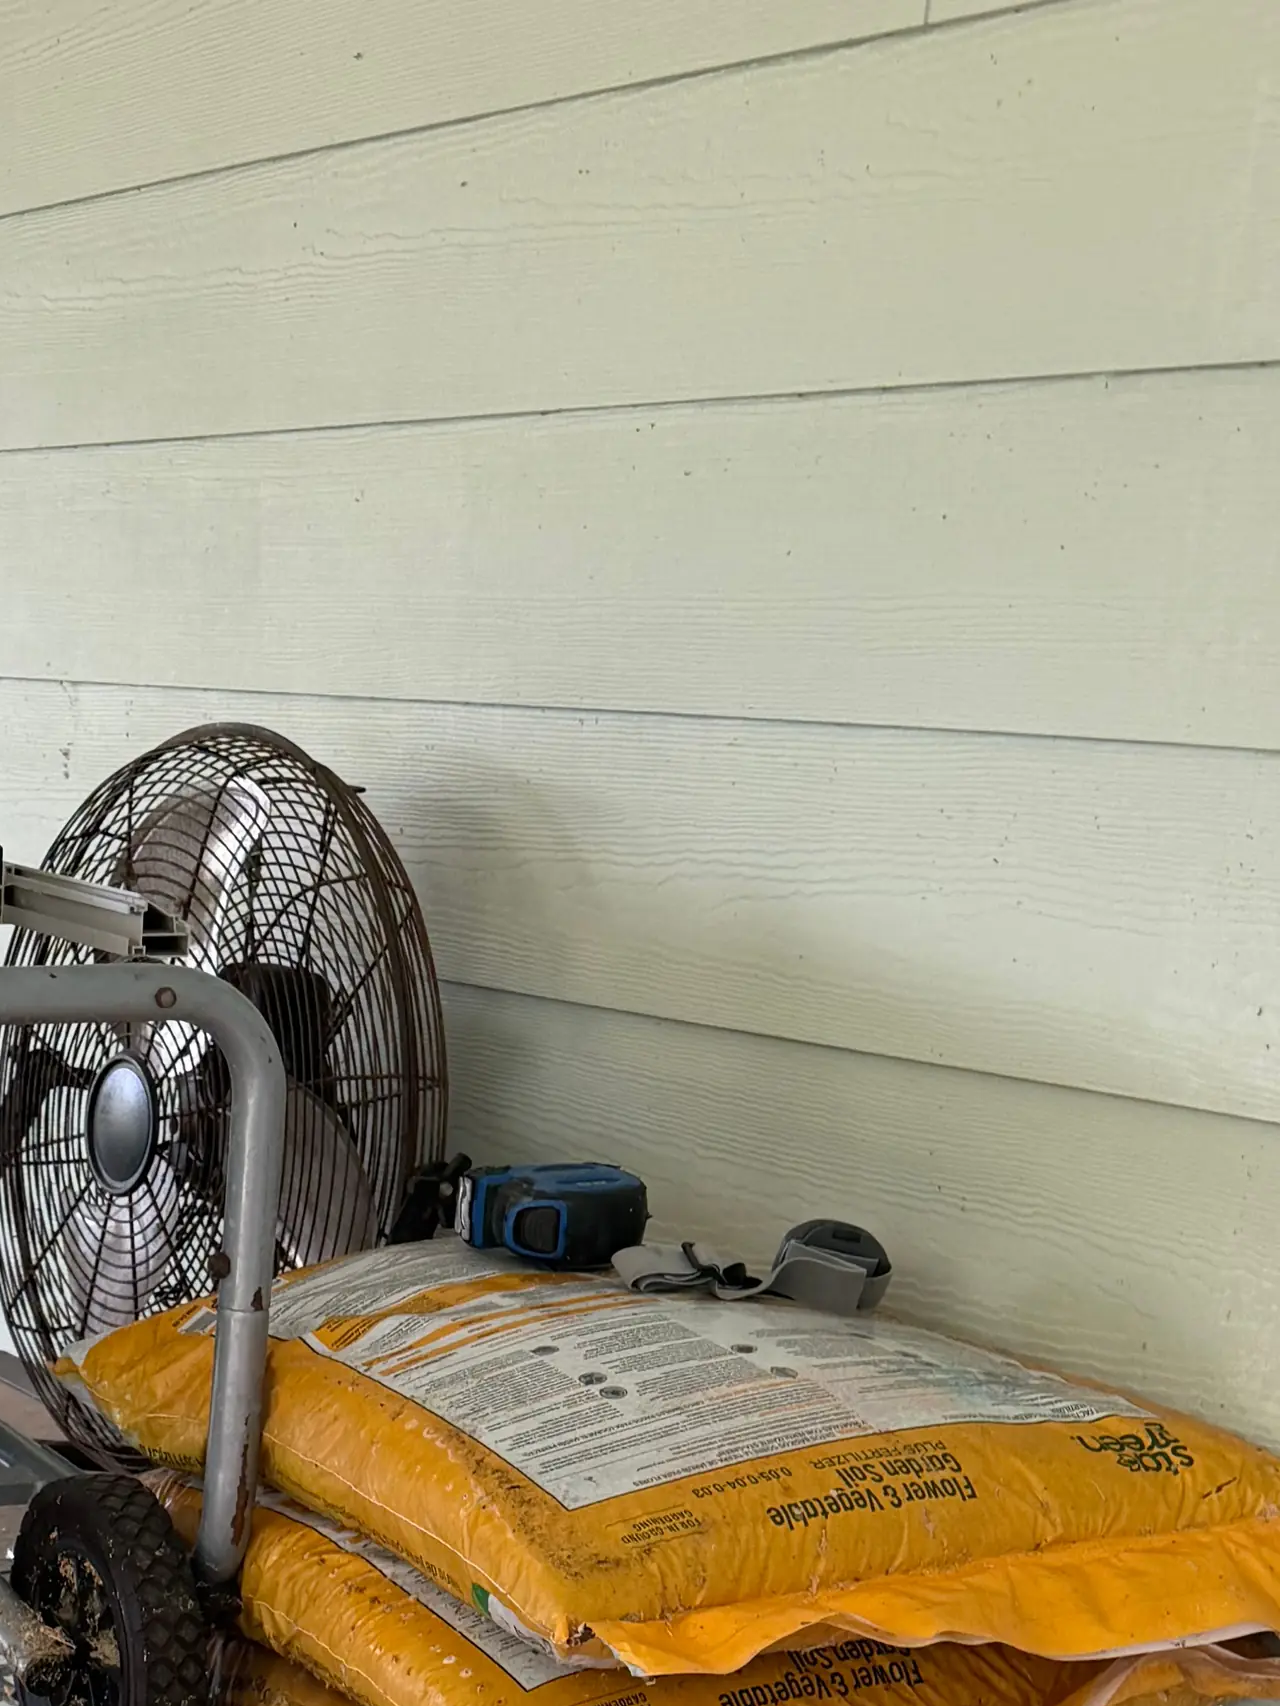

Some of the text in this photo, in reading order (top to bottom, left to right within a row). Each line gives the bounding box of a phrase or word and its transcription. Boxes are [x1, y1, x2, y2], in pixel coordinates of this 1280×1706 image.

[809, 1440, 948, 1470] PLUS FERTILIZER
[1139, 1445, 1194, 1476] sta
[835, 1452, 962, 1490] Garden Soil
[766, 1475, 977, 1531] Flower & Vegetable
[632, 1509, 694, 1532] GARDENING
[680, 1517, 702, 1531] FOR
[830, 1671, 849, 1697] &
[850, 1659, 924, 1691] Flower
